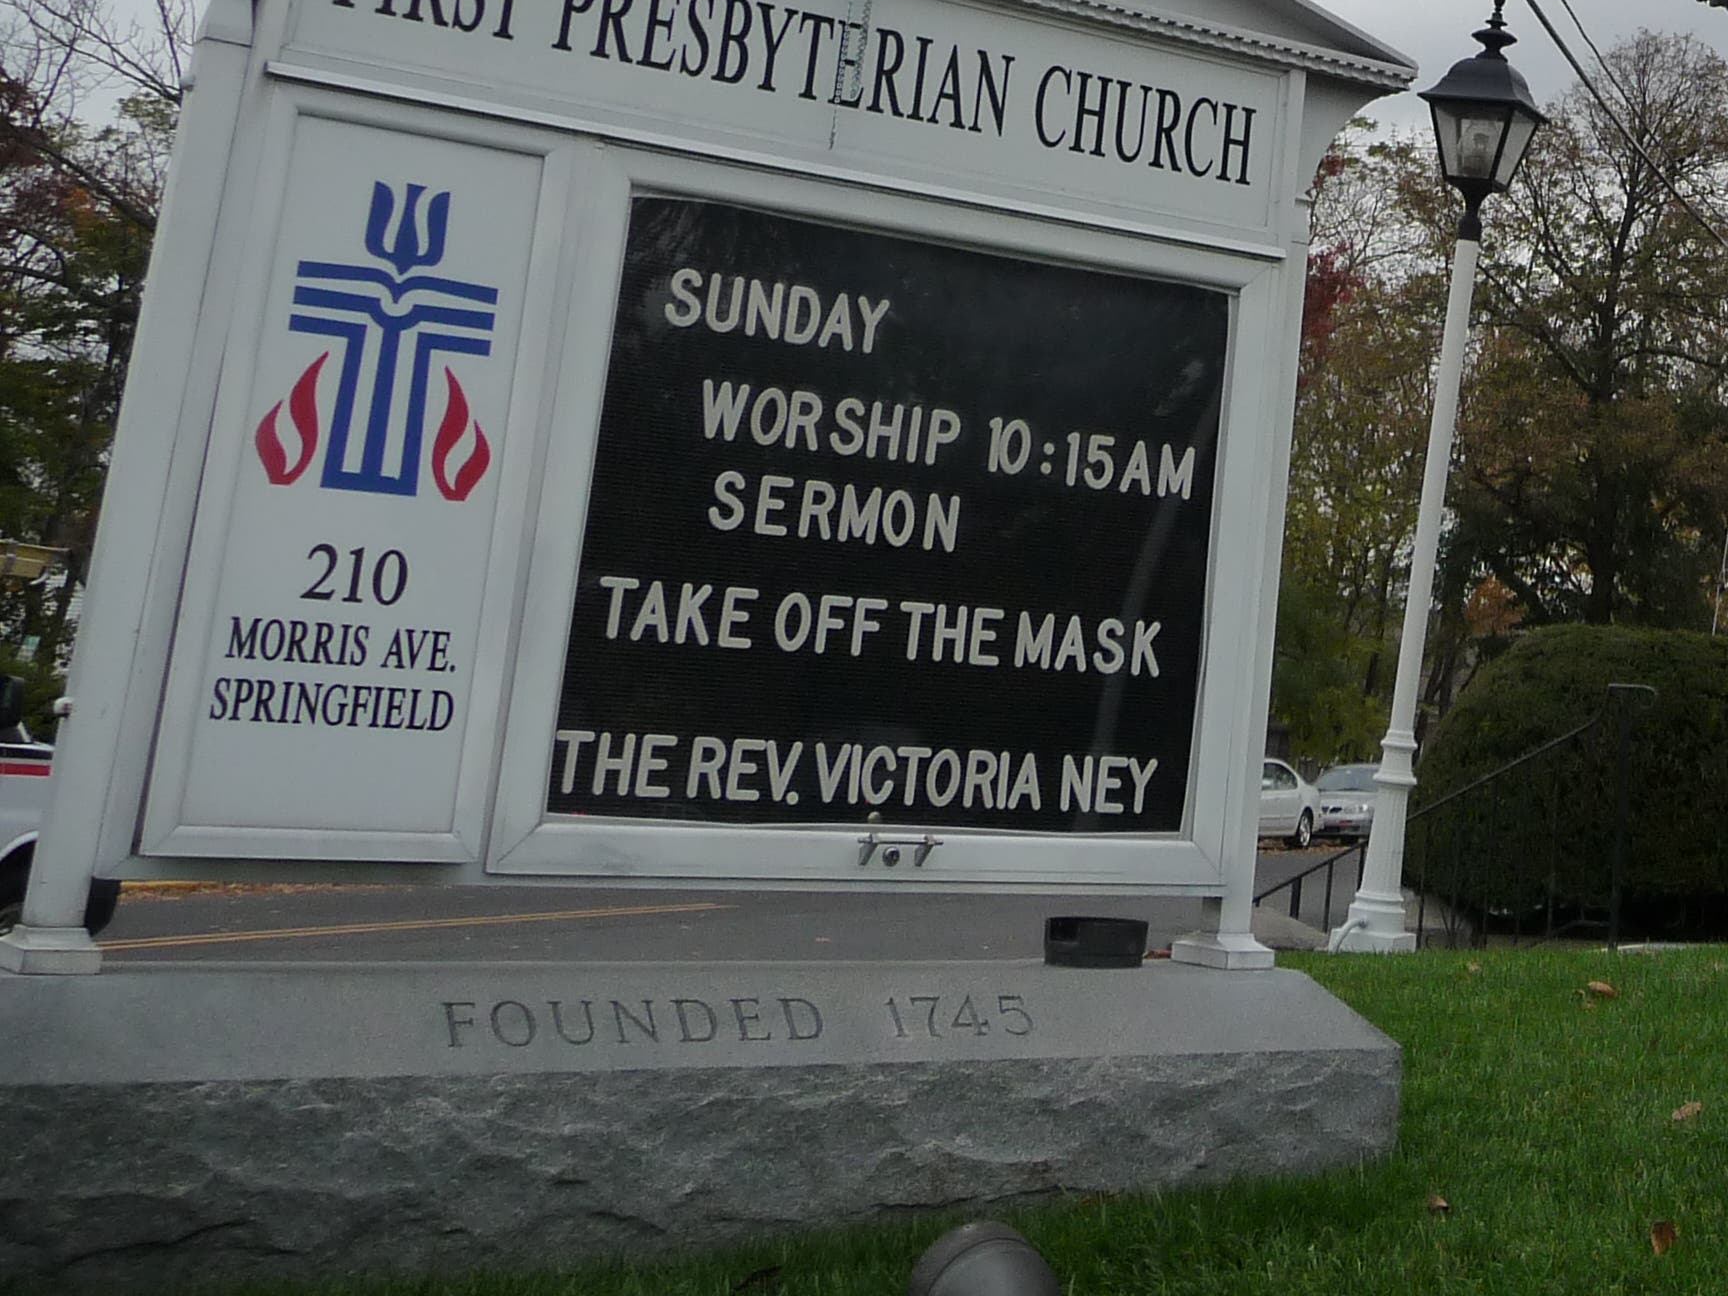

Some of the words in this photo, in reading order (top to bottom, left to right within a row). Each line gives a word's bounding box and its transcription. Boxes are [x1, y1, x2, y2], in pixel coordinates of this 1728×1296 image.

[1034, 65, 1257, 186] CHURCH
[664, 267, 890, 354] SUNDAY
[703, 378, 962, 466] WORSHIP
[708, 470, 961, 553] SERMON
[299, 543, 409, 606] 210
[224, 616, 370, 667] MORRIS
[380, 627, 456, 673] AVE.
[600, 575, 760, 649] TAKE
[774, 592, 889, 657] OFF
[901, 601, 1005, 667] THE
[1014, 611, 1162, 678] MASK
[209, 677, 455, 732] SPRINGFIELD
[556, 729, 678, 798] THE
[687, 736, 804, 805] REV.
[815, 742, 1041, 812] VICTORIA
[1060, 754, 1158, 815] NEY
[442, 998, 823, 1047] FOUNDED
[885, 994, 1034, 1039] 1745
